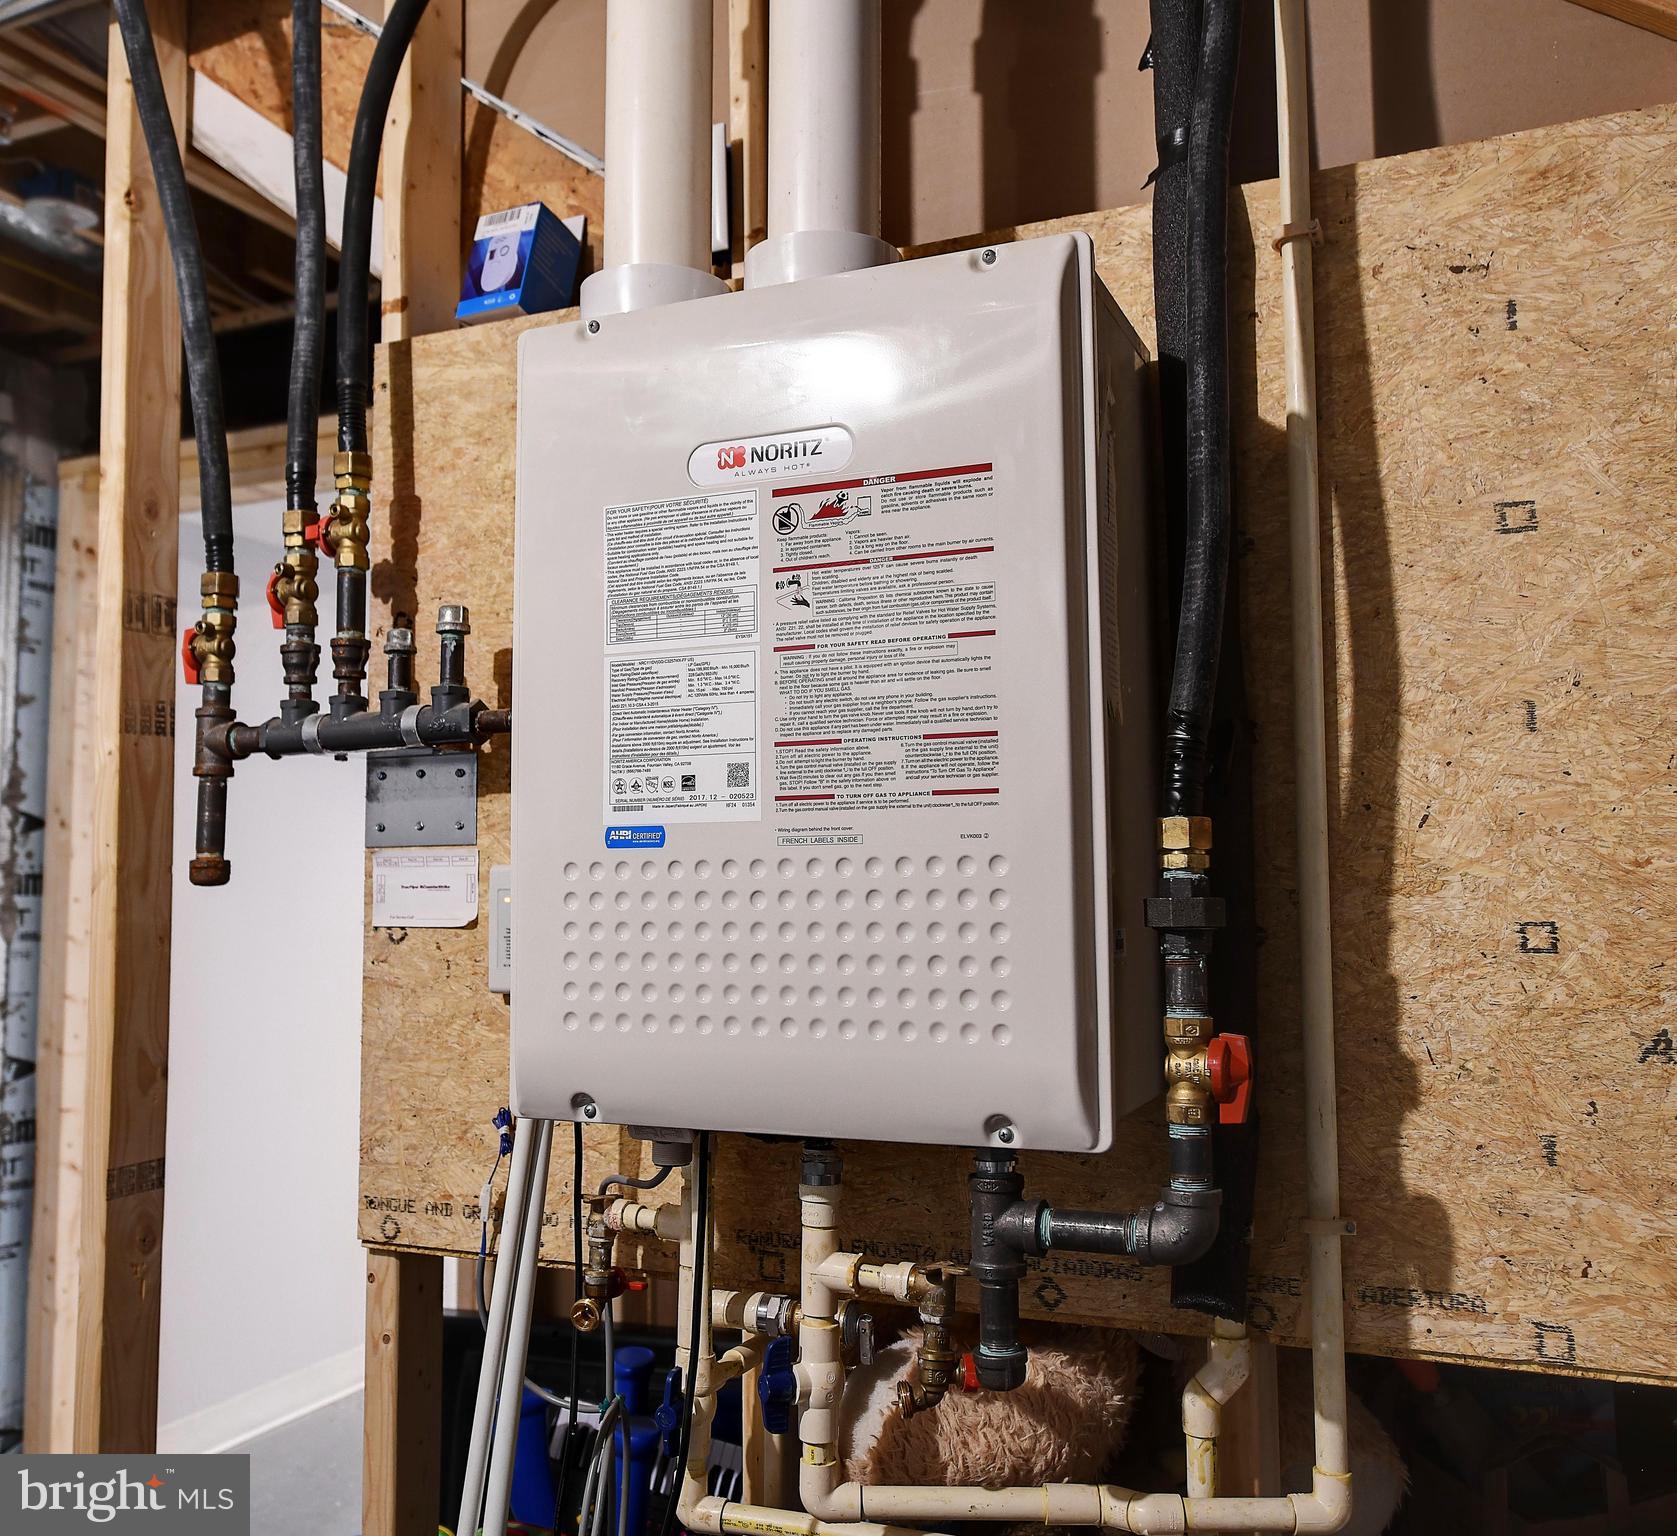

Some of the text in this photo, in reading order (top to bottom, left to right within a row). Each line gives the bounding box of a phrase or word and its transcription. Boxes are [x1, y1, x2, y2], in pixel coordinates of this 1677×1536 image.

[751, 438, 823, 463] NORITZ
[734, 467, 777, 477] ALWAYS
[863, 476, 896, 486] DANGER
[869, 556, 894, 564] DANGER
[609, 830, 632, 840] AHRI
[364, 1195, 416, 1214] TONGUE
[425, 1200, 454, 1218] AND
